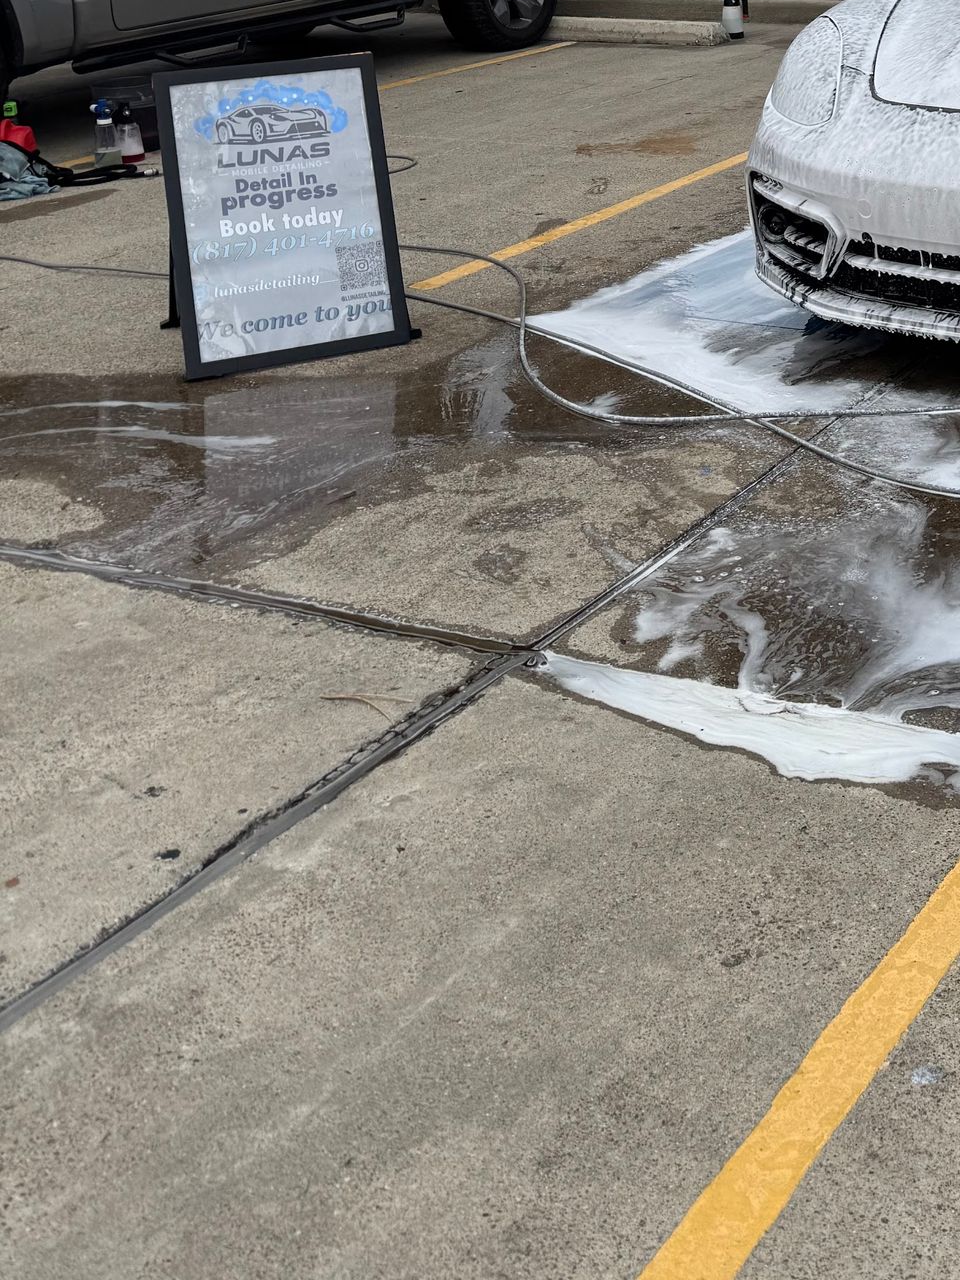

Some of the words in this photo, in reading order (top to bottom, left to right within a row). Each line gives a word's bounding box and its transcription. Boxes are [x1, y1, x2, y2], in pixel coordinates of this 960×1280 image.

[217, 142, 331, 168] LUNAS
[231, 166, 268, 177] MOBILE
[272, 160, 322, 173] DETAILING
[235, 172, 292, 193] Detail
[299, 171, 318, 186] In
[221, 183, 338, 216] progress
[219, 213, 276, 238] Book
[282, 206, 344, 231] today
[191, 236, 258, 265] (817)
[263, 222, 375, 257] 401-4716
[196, 320, 235, 340] We
[240, 311, 308, 335] come
[314, 305, 340, 323] to
[345, 299, 393, 322] you
